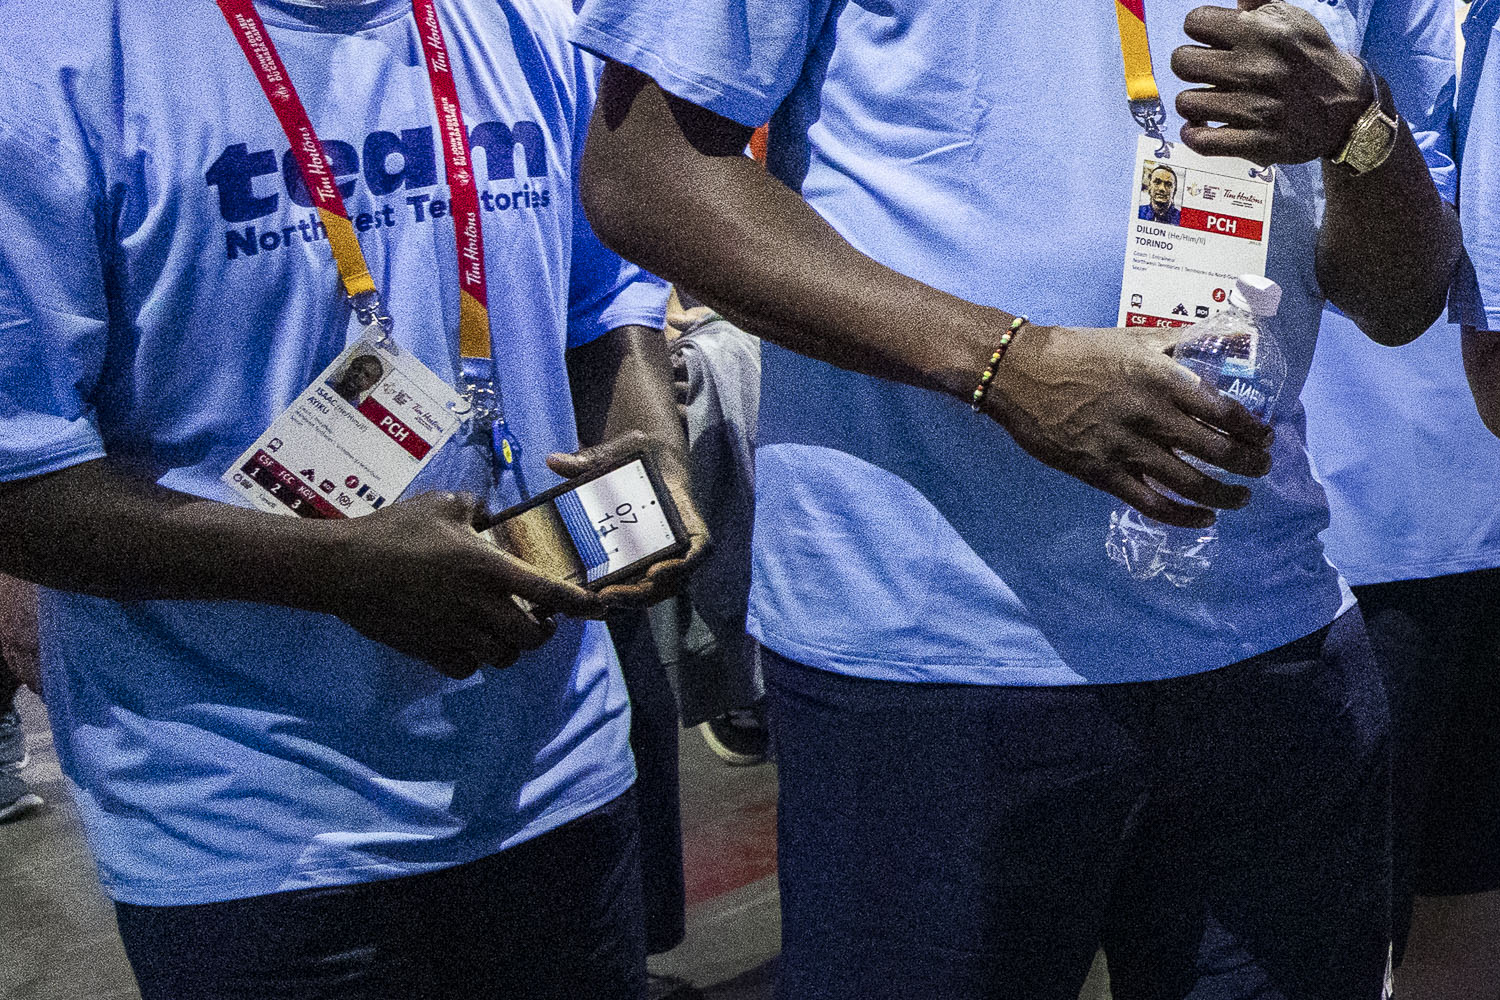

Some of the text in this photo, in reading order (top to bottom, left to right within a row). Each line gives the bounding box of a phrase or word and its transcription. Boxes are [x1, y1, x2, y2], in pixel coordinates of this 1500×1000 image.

[424, 3, 449, 73] Tim Hortons
[205, 120, 548, 223] team
[299, 127, 336, 203] Tim Hortons
[1224, 188, 1236, 200] Tim
[1236, 191, 1263, 205] Hortons
[225, 184, 551, 260] Northest Tetories
[1136, 224, 1166, 238] DILLON
[1206, 215, 1237, 234] PCH
[460, 211, 483, 285] Tim Hortons
[1135, 236, 1174, 251] TORINDO
[1131, 315, 1147, 325] CSF
[315, 386, 338, 407] ISAAC
[380, 415, 410, 442] PCH
[258, 453, 275, 467] CSF
[278, 469, 296, 485] FCC
[250, 467, 302, 509] 1 2 3
[598, 512, 619, 538] 11
[615, 502, 638, 524] 07
